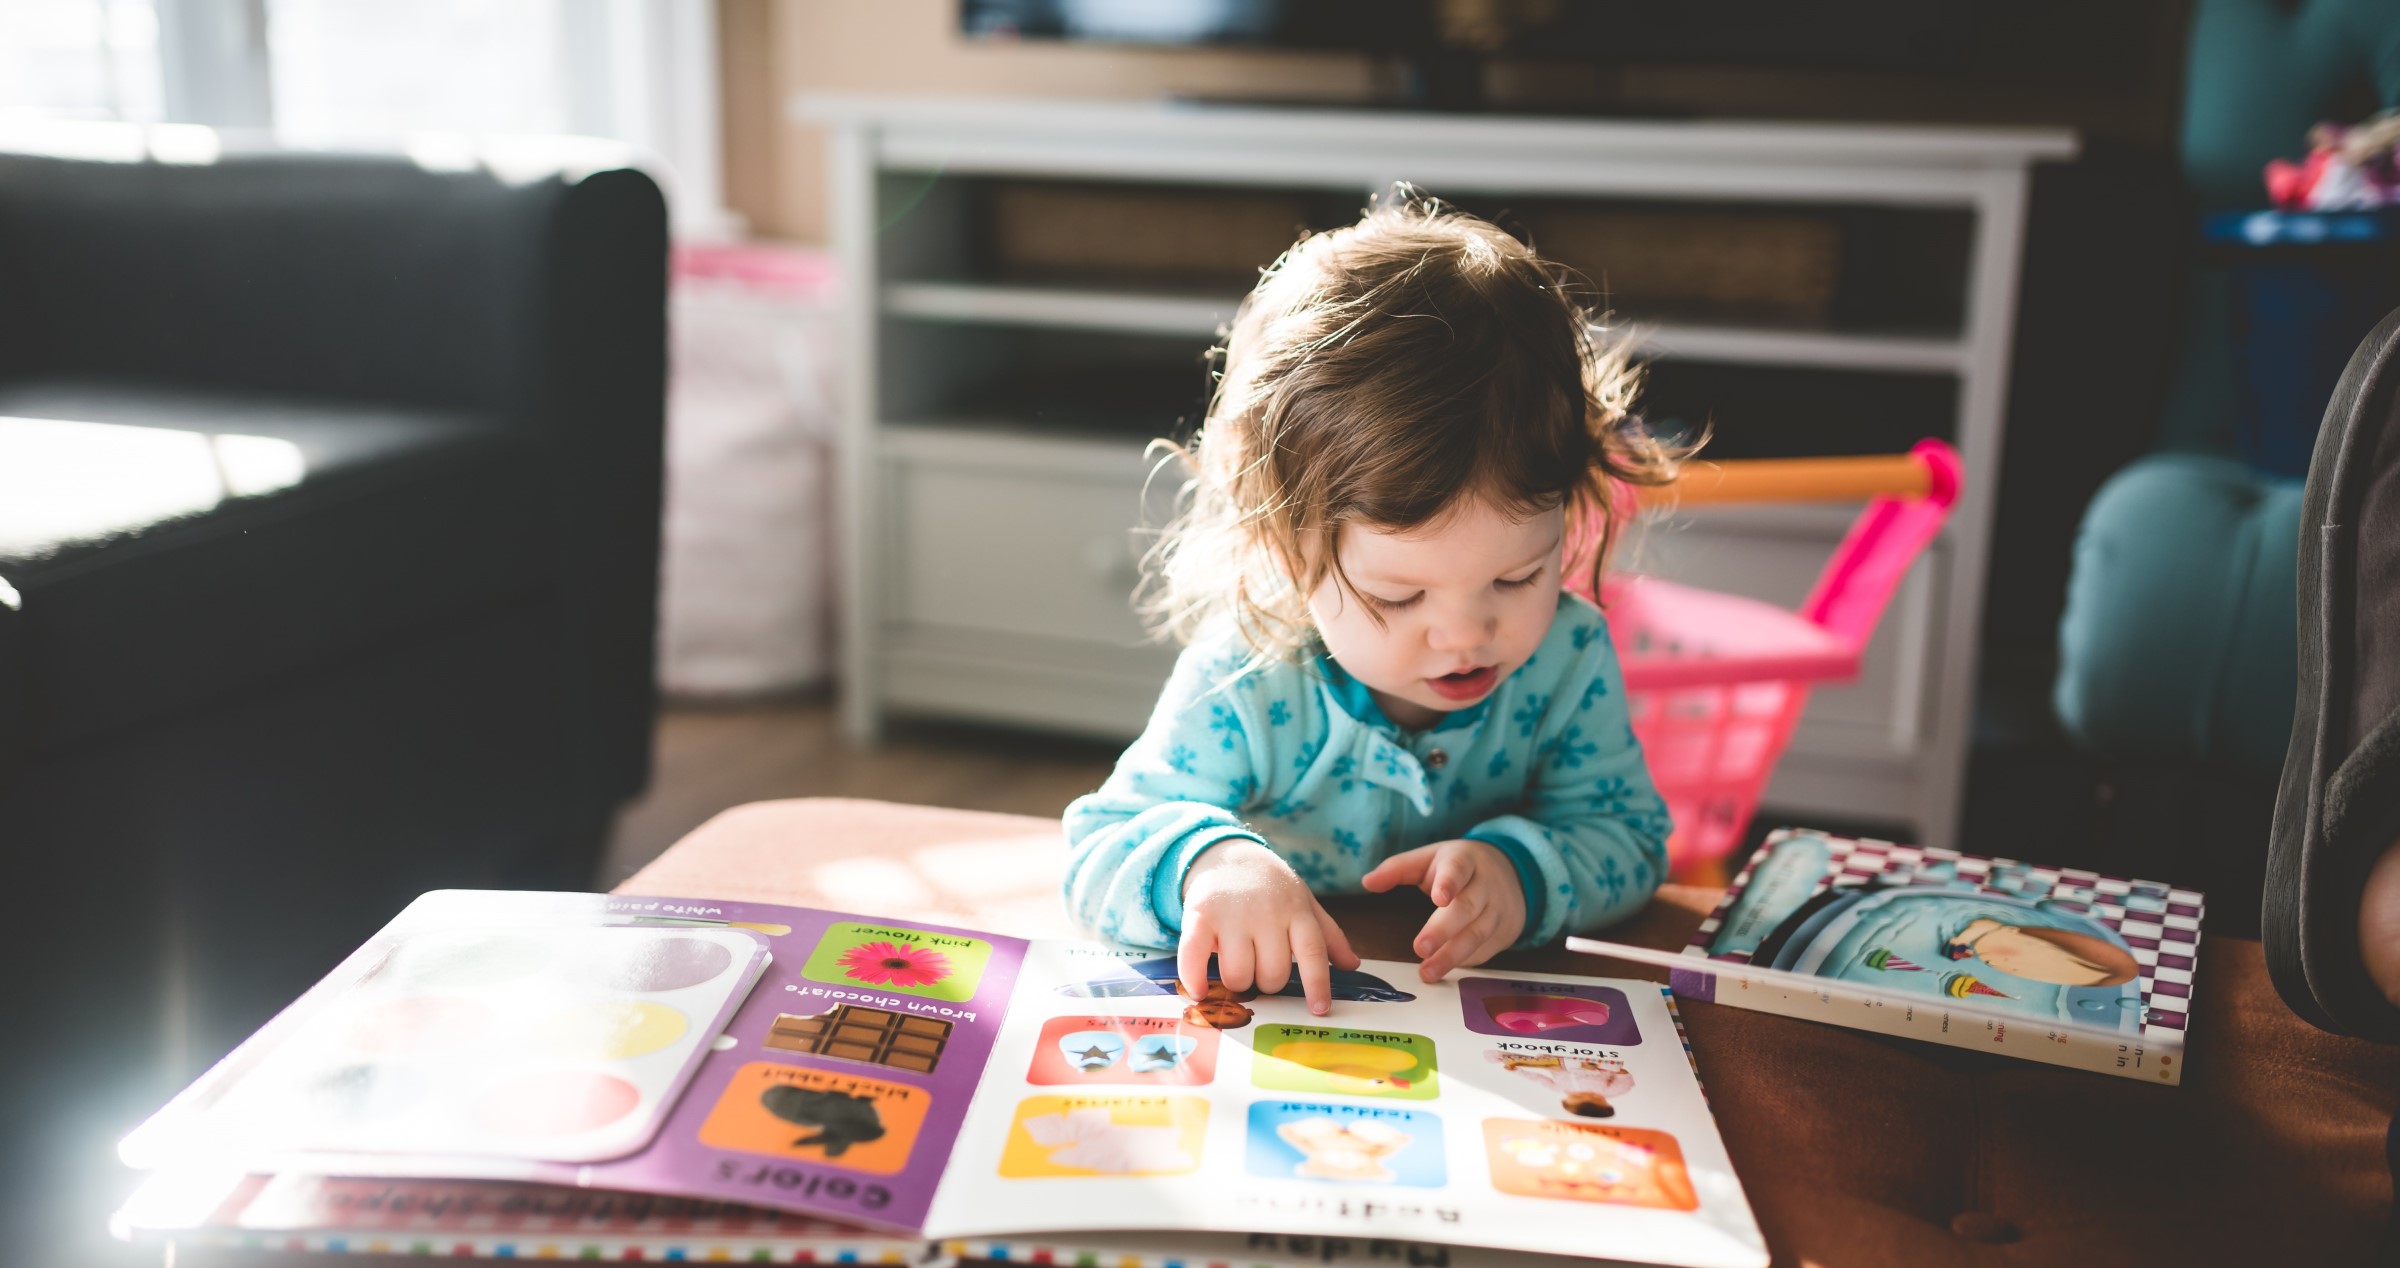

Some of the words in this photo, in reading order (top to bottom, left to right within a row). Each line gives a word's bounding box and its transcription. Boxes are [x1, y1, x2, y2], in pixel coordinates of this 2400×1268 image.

[850, 925, 921, 943] flower
[929, 935, 972, 950] pink
[784, 984, 901, 1009] chocolate
[907, 1000, 977, 1023] brown
[1279, 1027, 1331, 1042] duck
[1338, 1030, 1414, 1045] rubber
[1495, 1042, 1620, 1061] storybook
[761, 1068, 840, 1088] rabbit
